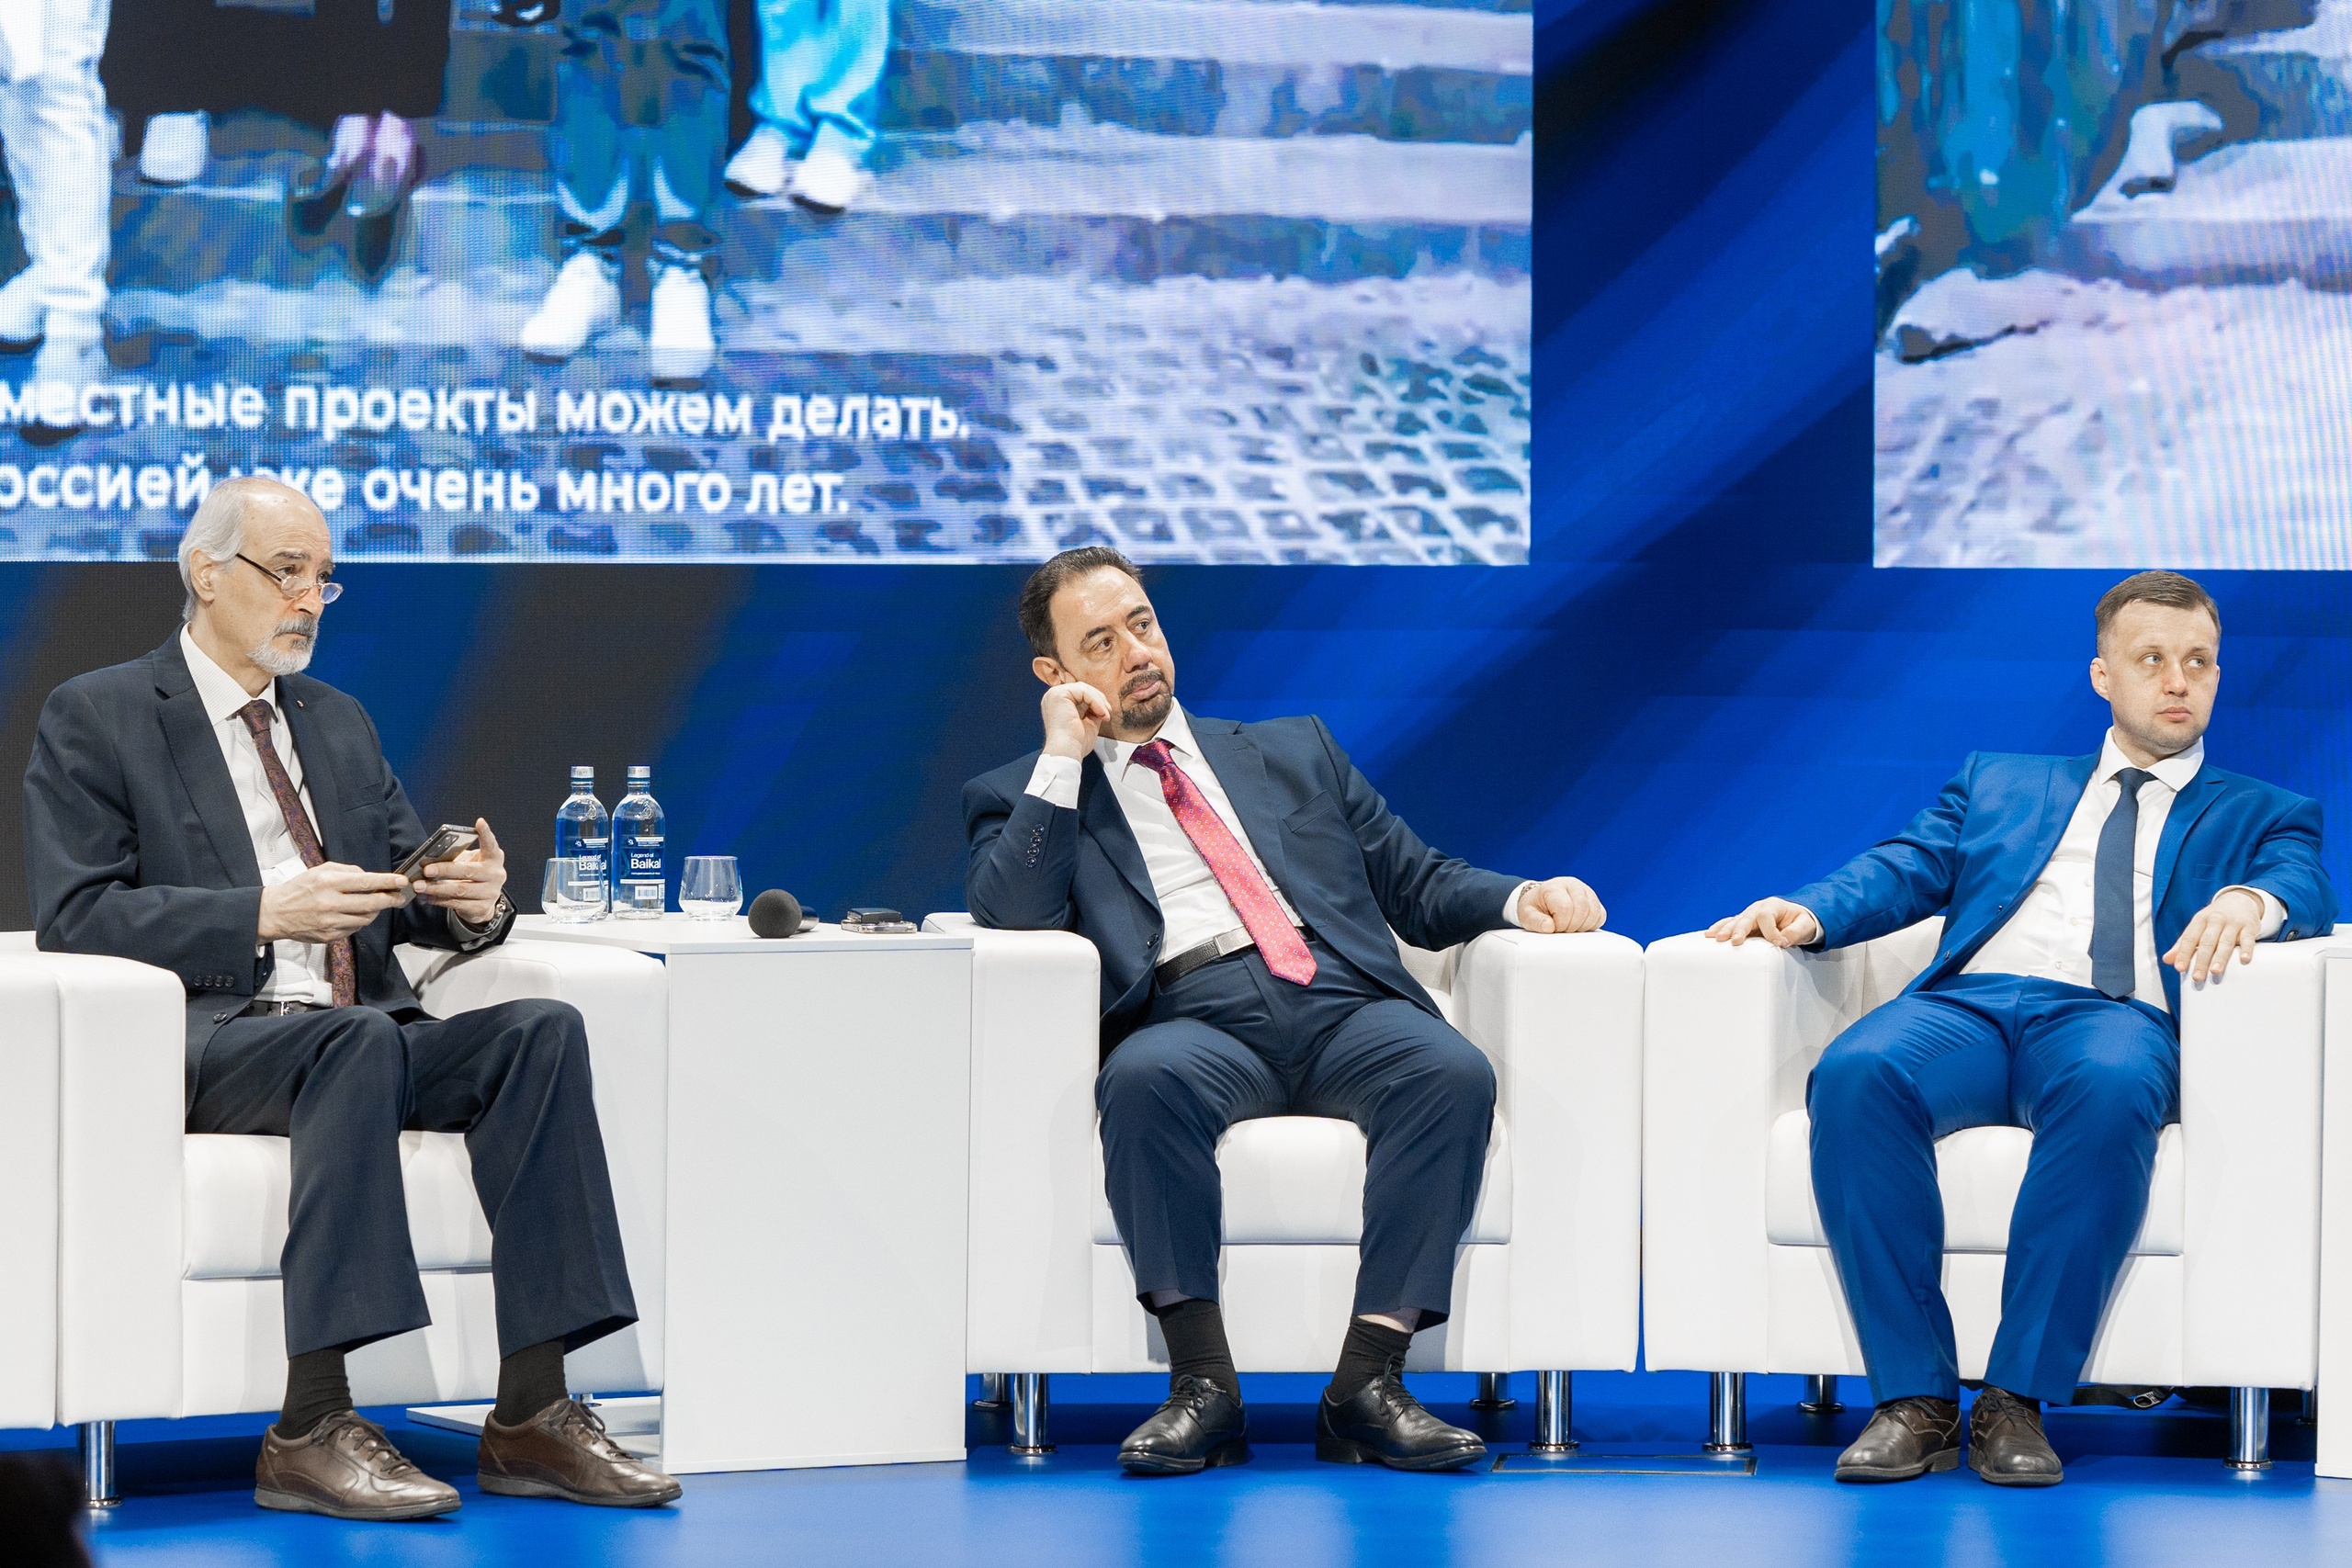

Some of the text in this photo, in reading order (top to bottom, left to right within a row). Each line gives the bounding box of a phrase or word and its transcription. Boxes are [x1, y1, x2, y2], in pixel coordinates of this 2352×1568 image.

[284, 385, 537, 441] проекты
[556, 389, 752, 435] можем
[767, 394, 970, 443] делать.
[363, 467, 540, 512] очень
[556, 469, 732, 513] много
[744, 471, 850, 514] лет.
[630, 858, 662, 869] Baikal
